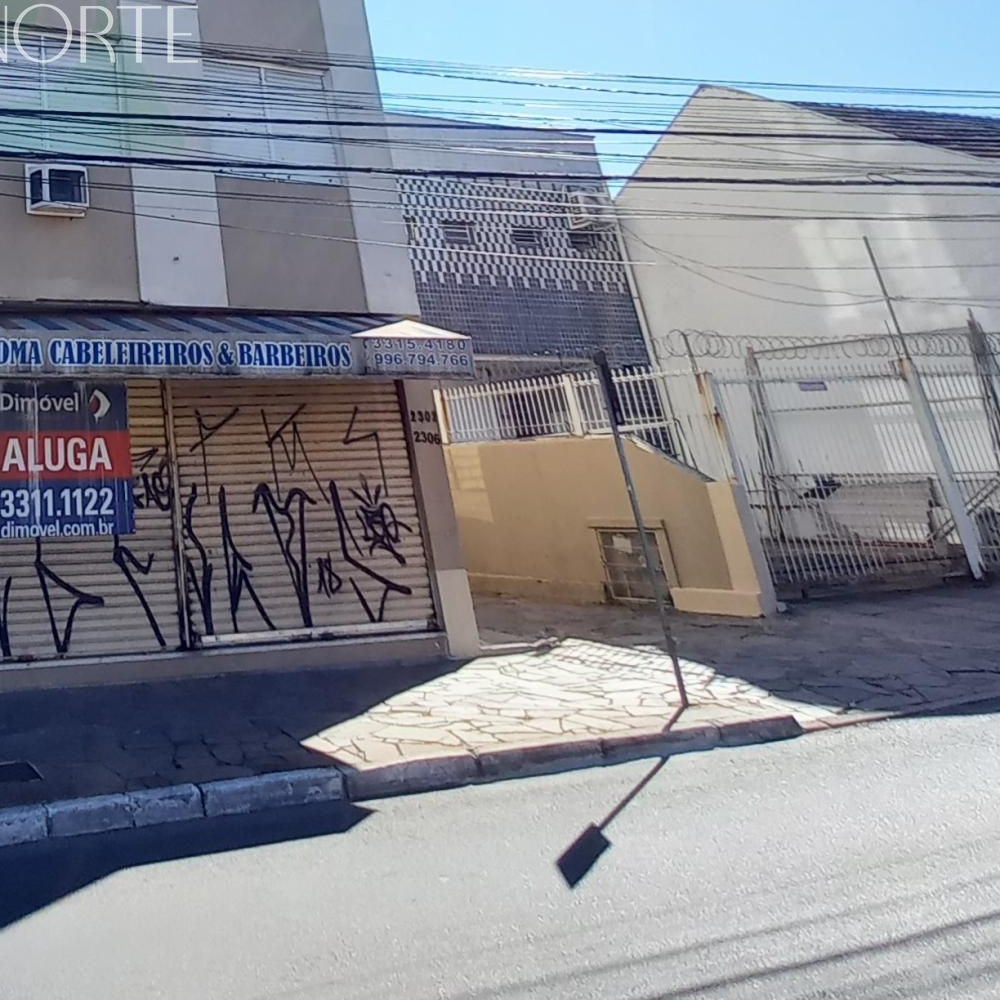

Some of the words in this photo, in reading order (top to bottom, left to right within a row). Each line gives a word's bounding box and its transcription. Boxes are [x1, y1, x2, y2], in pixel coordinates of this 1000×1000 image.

[49, 338, 214, 367] CABELEIREIROS
[217, 341, 236, 367] &
[236, 341, 352, 368] BARBEIROS
[0, 392, 79, 412] Dimóvel
[2, 437, 112, 472] ALUGA
[0, 487, 114, 518] 3311.1122
[1, 520, 114, 538] dimovel.com.br
